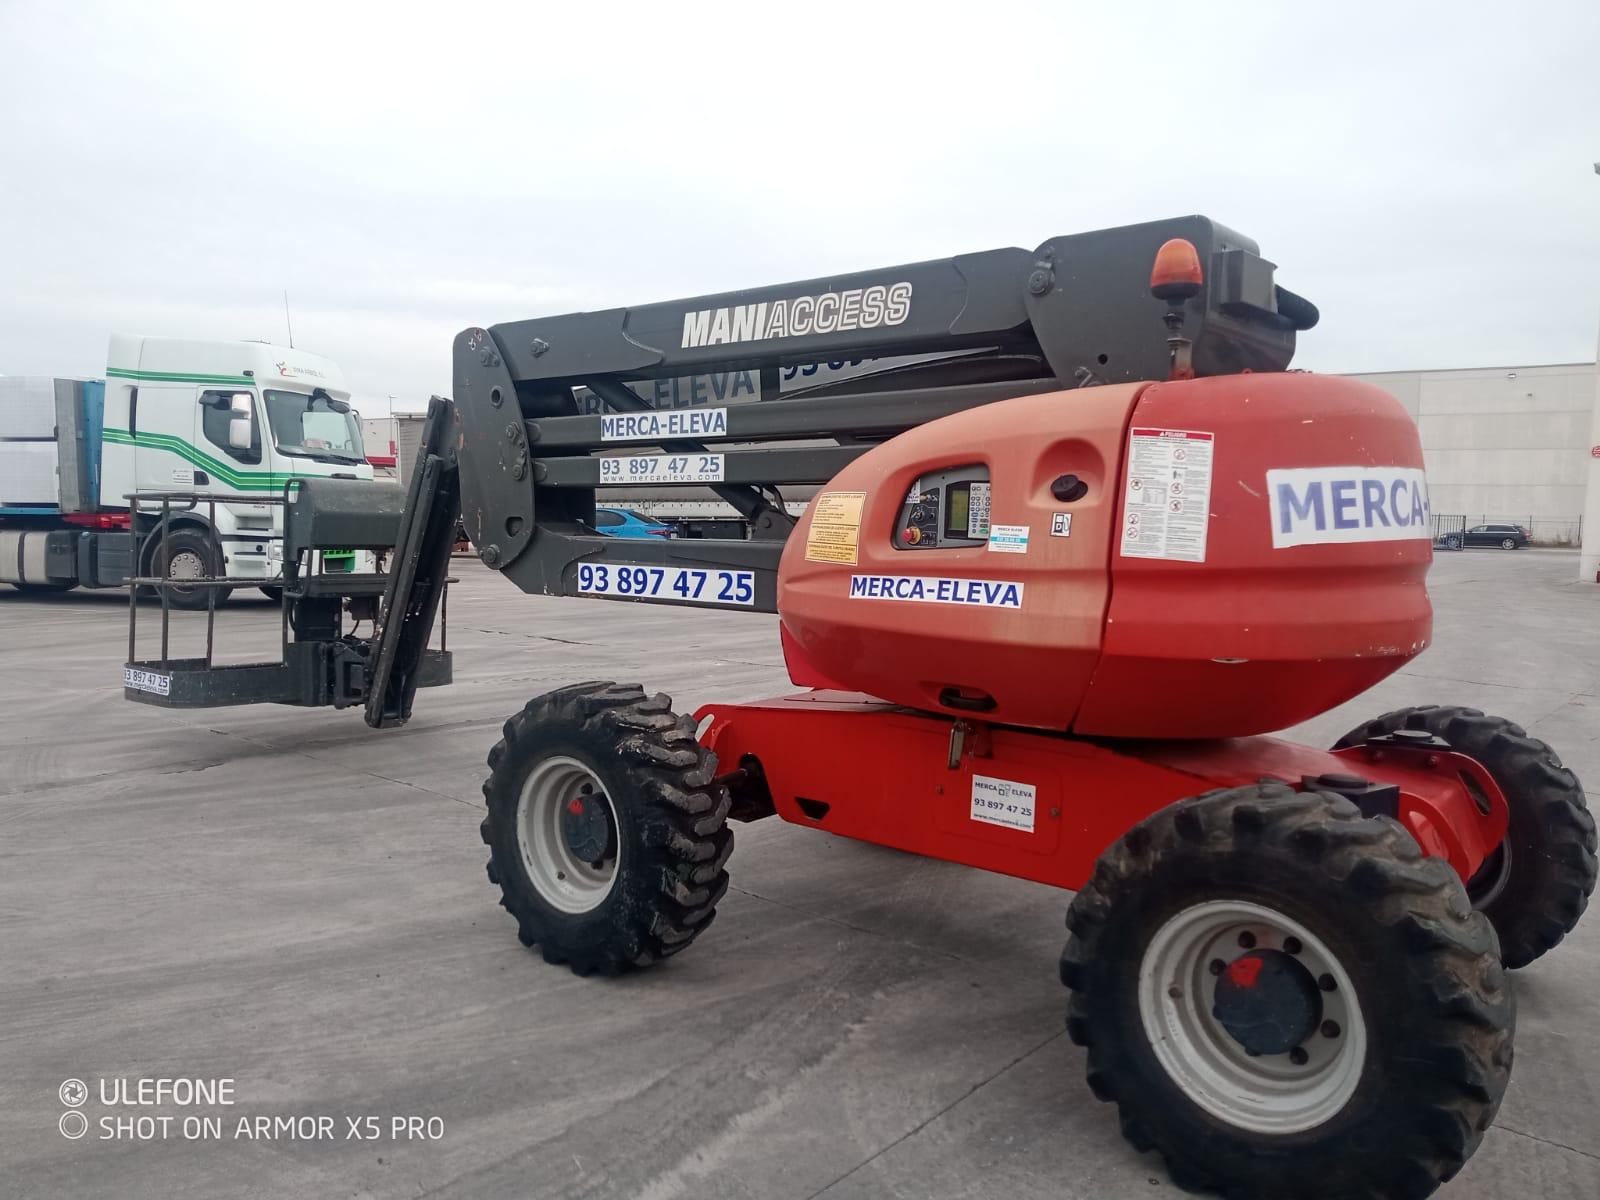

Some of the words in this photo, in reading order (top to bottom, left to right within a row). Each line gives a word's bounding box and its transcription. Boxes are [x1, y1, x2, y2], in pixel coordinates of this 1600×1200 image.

[682, 282, 912, 348] MANIACCESS
[602, 412, 726, 437] MERCA-ELEVA
[602, 459, 620, 475] 93
[629, 458, 658, 475] 897
[668, 457, 688, 473] 47
[699, 456, 720, 473] 25
[603, 473, 720, 482] www.mercaeleva.com
[580, 565, 609, 592] 93
[617, 567, 665, 595] 897
[673, 570, 707, 598] 47
[717, 572, 752, 602] 25
[851, 577, 1020, 606] MERCA-ELEVA
[133, 671, 146, 683] 897
[148, 674, 157, 686] 47
[158, 676, 168, 688] 25
[975, 782, 997, 791] MERCA
[1011, 789, 1032, 798] ELEVA
[974, 798, 985, 807] 93
[987, 801, 1004, 810] 897
[1006, 805, 1018, 813] 47
[1021, 807, 1032, 817] 25
